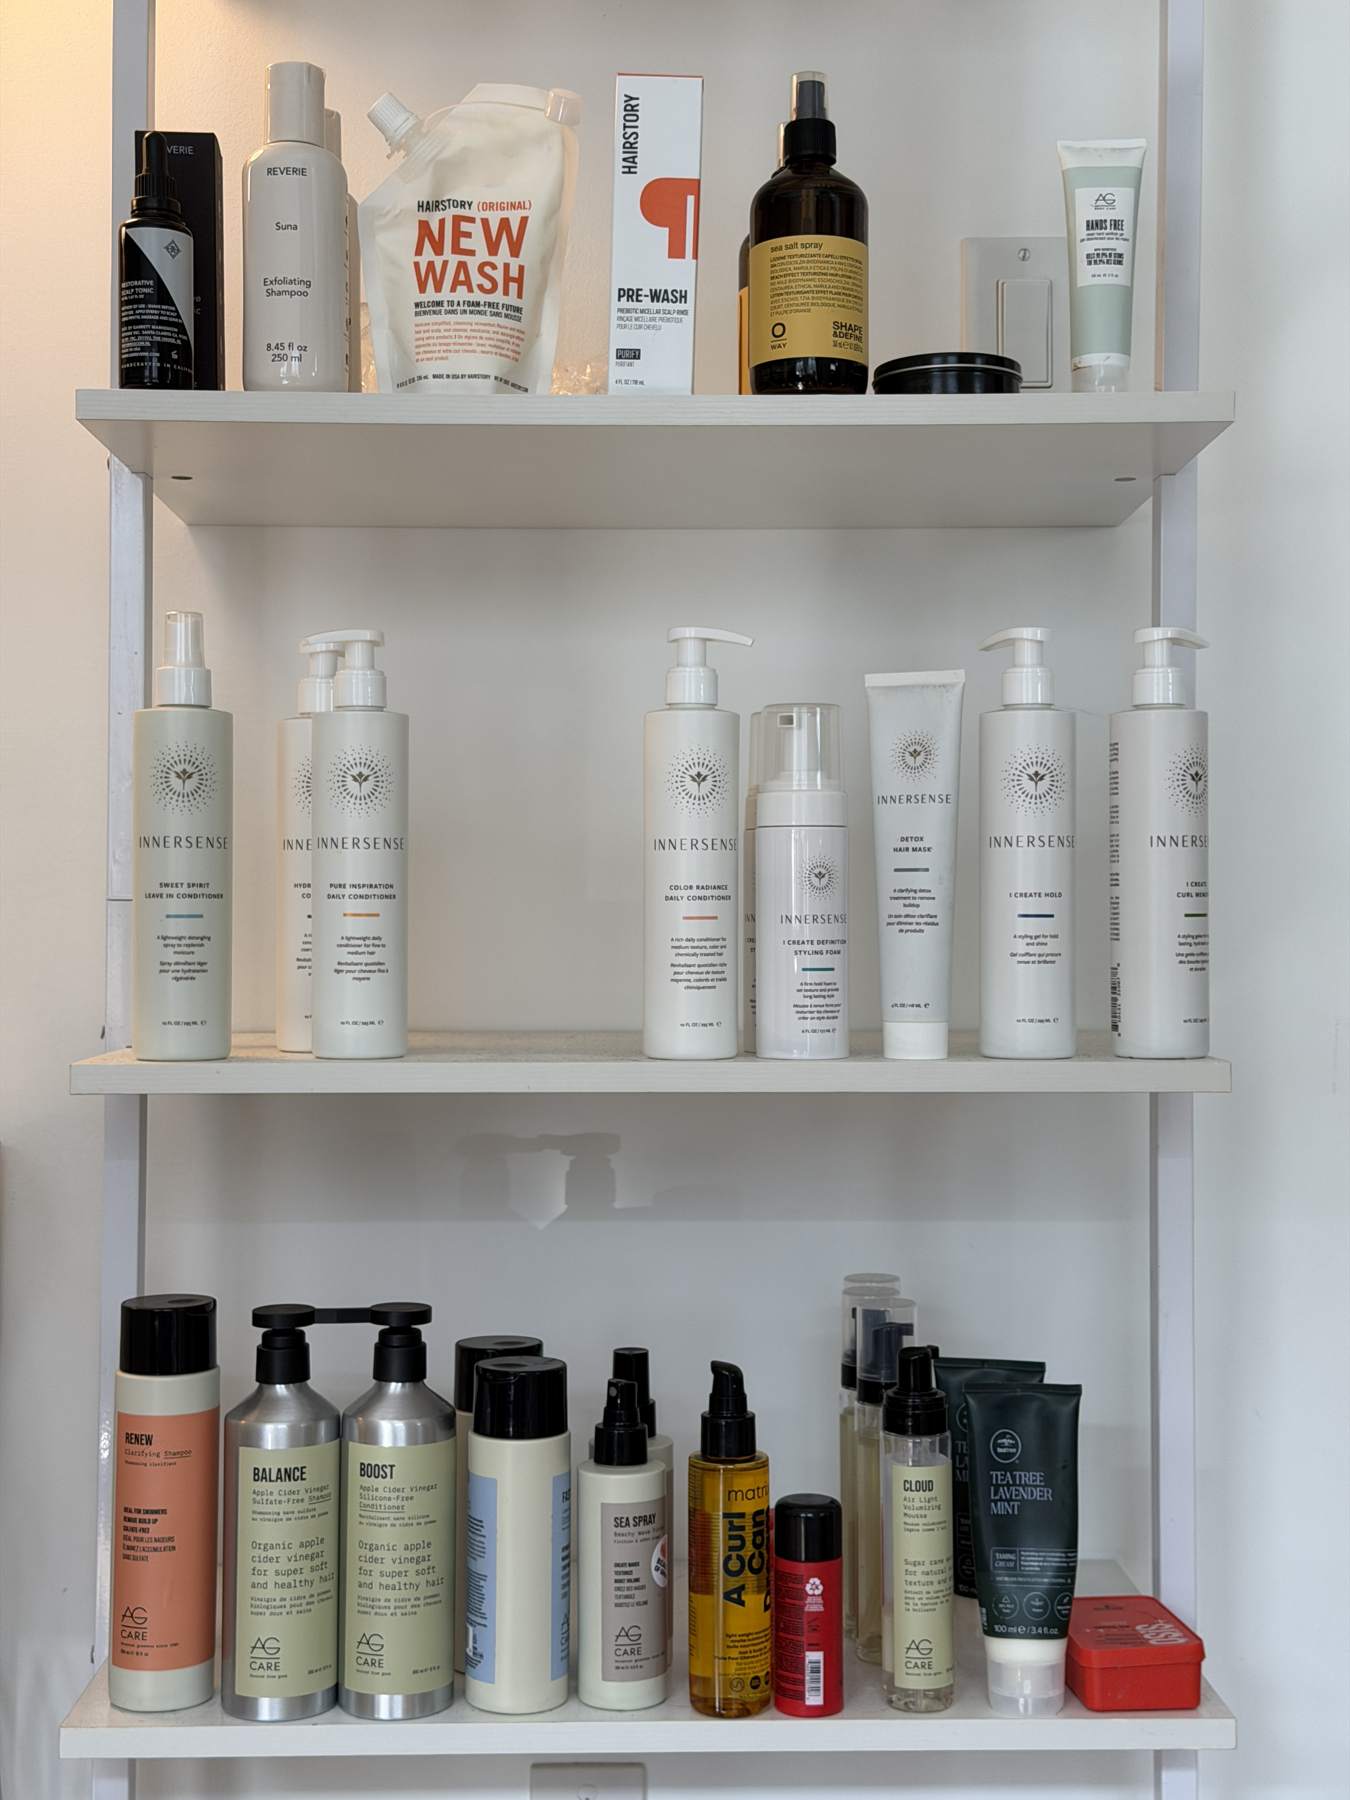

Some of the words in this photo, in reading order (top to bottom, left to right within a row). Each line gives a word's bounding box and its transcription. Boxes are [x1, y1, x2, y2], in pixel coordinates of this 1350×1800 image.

[622, 94, 640, 174] HAIRSTORY
[167, 146, 194, 154] VERIE
[267, 168, 307, 176] REVERIE
[1095, 193, 1116, 204] AG
[417, 199, 473, 212] HAIRSTORY
[477, 200, 532, 212] (ORIGINAL)
[276, 222, 298, 231] Suna
[1086, 220, 1107, 231] HANDS
[1110, 219, 1124, 231] FREE
[414, 214, 529, 258] NEW
[264, 278, 311, 288] Exfoliating
[413, 260, 525, 299] WASH
[266, 289, 308, 298] Shampoo
[618, 288, 687, 304] PRE-WASH
[414, 300, 444, 308] WELCOME
[463, 301, 499, 310] FOAM-FREE
[502, 304, 523, 314] FUTURE
[833, 321, 863, 335] SHAPE
[267, 343, 285, 351] 8.45
[288, 343, 294, 351] fl
[618, 350, 639, 358] PURIFY
[878, 794, 952, 805] INNERSENSE
[139, 836, 228, 849] INNERSENSE
[317, 837, 404, 850] INNERSENSE
[654, 838, 736, 851] INNERSENSE
[989, 835, 1074, 848] INNERSENSE
[781, 914, 847, 924] INNERSENSE
[125, 1432, 153, 1446] RENEW
[125, 1449, 160, 1458] Clarifying
[253, 1466, 306, 1482] BALANCE
[360, 1462, 395, 1479] BOOST
[990, 1472, 1012, 1484] TEA
[1014, 1472, 1044, 1485] TREE
[305, 1484, 329, 1494] Vinegar
[410, 1484, 437, 1492] Vinegar
[903, 1480, 934, 1492] CLOUD
[919, 1496, 938, 1504] Light
[990, 1486, 1052, 1501] LAVENDER
[360, 1501, 405, 1510] Conditioner
[904, 1504, 941, 1512] Volumizing
[990, 1502, 1020, 1515] MINT
[614, 1516, 630, 1529] SEA
[633, 1513, 656, 1527] SPRAY
[251, 1540, 292, 1552] Organic
[299, 1537, 324, 1550] apple
[358, 1540, 397, 1552] Organic
[404, 1540, 432, 1551] apple
[723, 1512, 746, 1577] Curl
[748, 1508, 765, 1575] Can
[251, 1553, 280, 1564] cider
[287, 1550, 324, 1564] vinegar
[358, 1555, 385, 1564] cider
[392, 1554, 431, 1565] vinegar
[904, 1559, 925, 1568] Sugar
[251, 1568, 268, 1576] for
[275, 1568, 304, 1578] super
[310, 1562, 327, 1572] soft
[358, 1567, 373, 1576] for
[379, 1569, 408, 1578] super
[415, 1566, 436, 1576] soft
[921, 1567, 947, 1576] natural
[251, 1581, 268, 1589] and
[274, 1577, 314, 1589] healthy
[320, 1572, 334, 1583] hair
[358, 1581, 373, 1590] and
[379, 1581, 420, 1592] healthy
[426, 1577, 444, 1588] hair
[723, 1584, 746, 1607] A
[121, 1606, 147, 1625] AG
[121, 1630, 147, 1640] CARE
[615, 1625, 642, 1642] AG
[250, 1637, 280, 1655] AG
[356, 1632, 384, 1652] AG
[905, 1638, 933, 1656] AG
[615, 1646, 642, 1657] CARE
[250, 1661, 280, 1671] CARE
[356, 1656, 384, 1668] CARE
[905, 1661, 933, 1670] CARE
